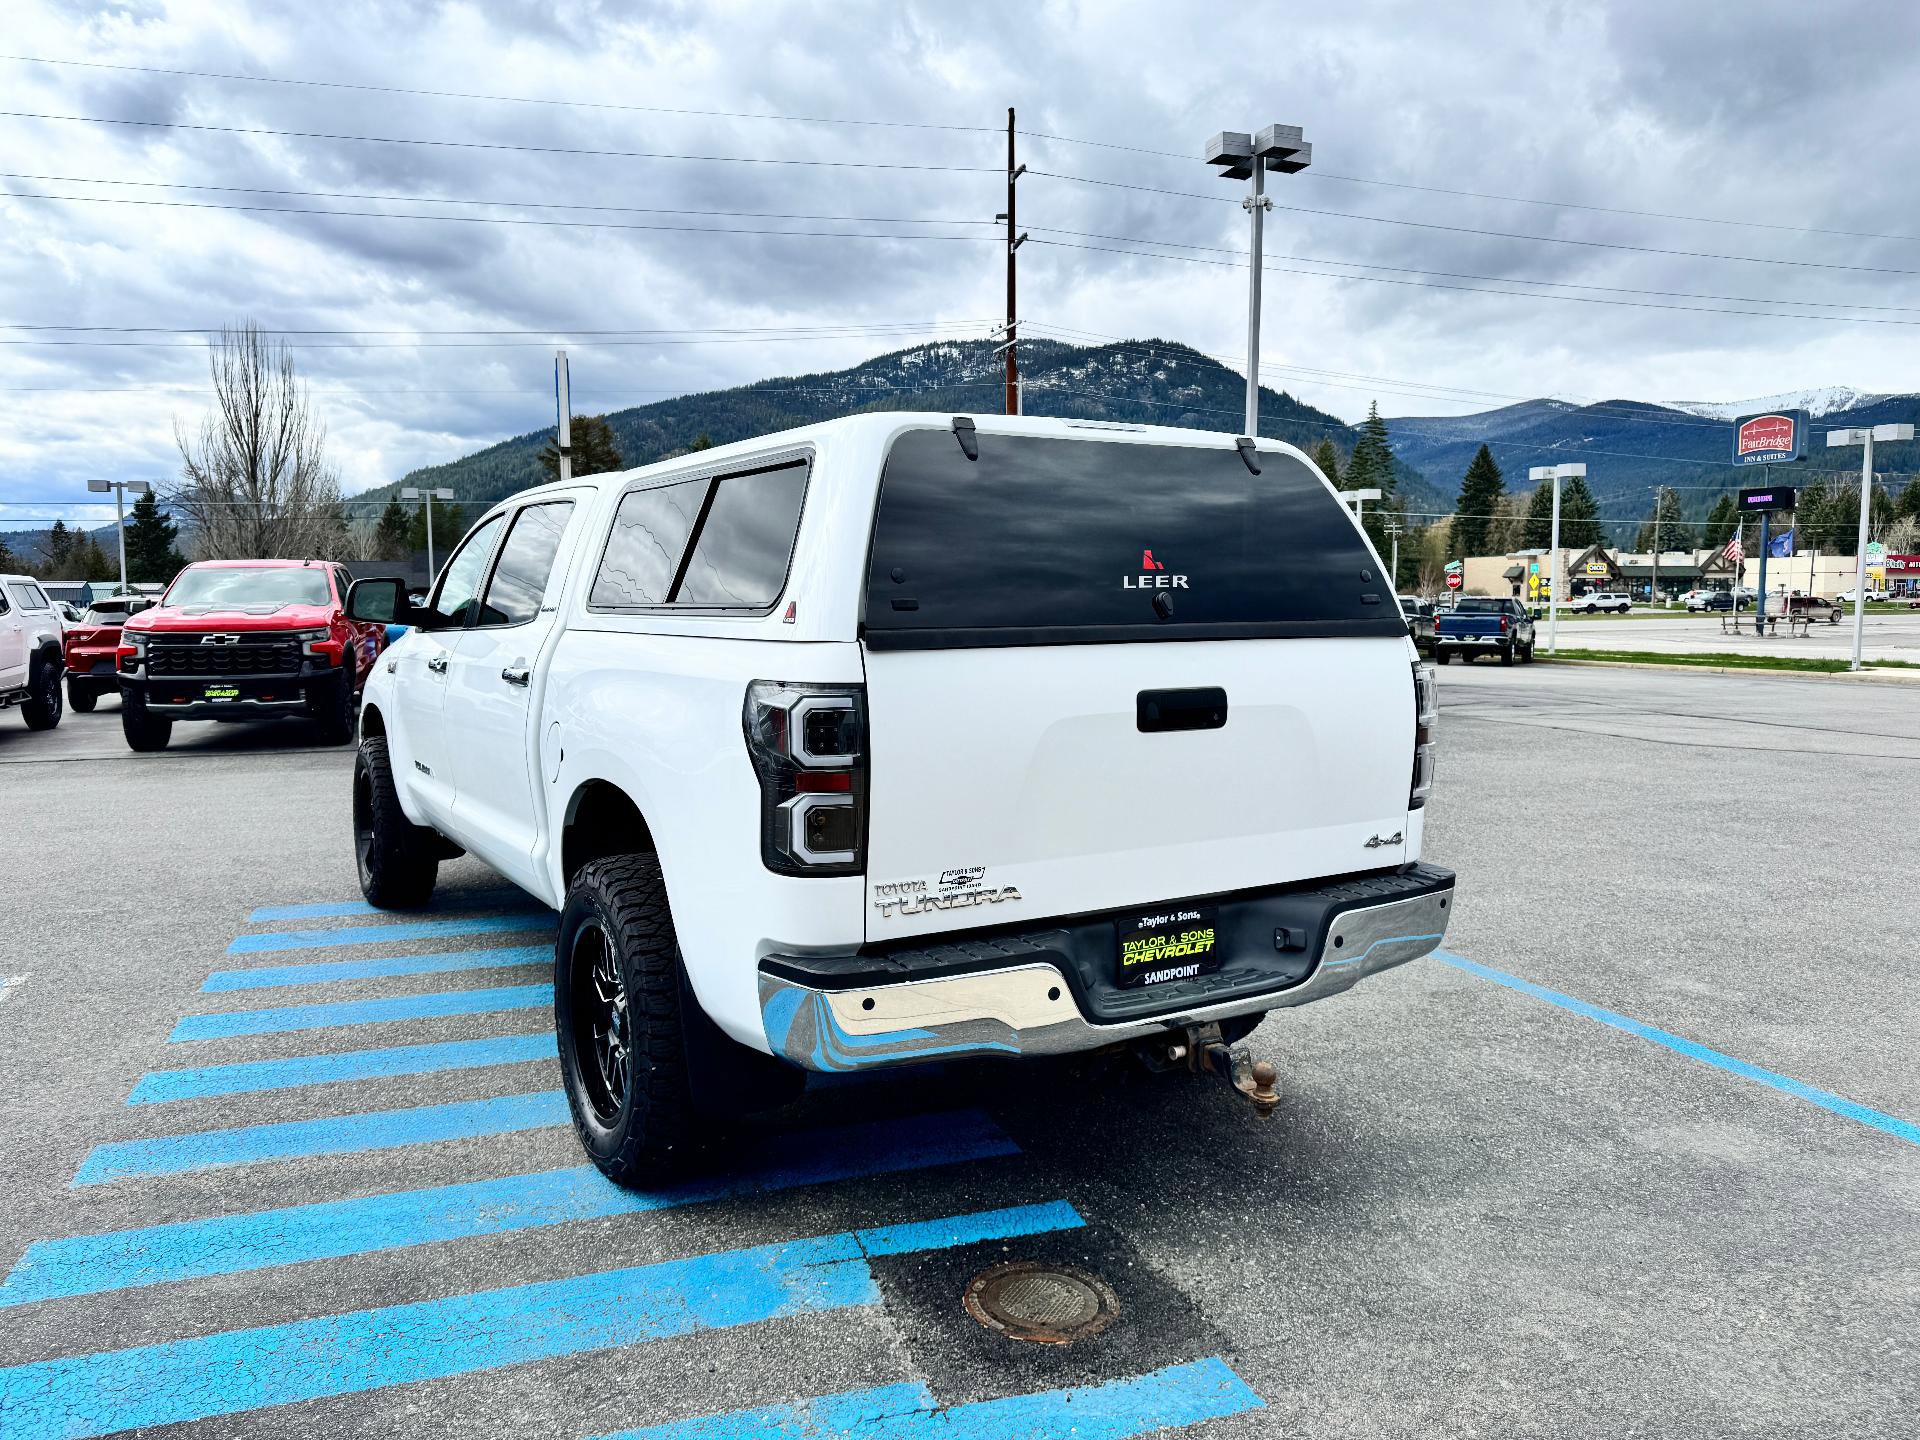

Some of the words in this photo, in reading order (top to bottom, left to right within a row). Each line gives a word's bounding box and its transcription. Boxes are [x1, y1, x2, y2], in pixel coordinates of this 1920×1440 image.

[1741, 435, 1791, 449] FairBridge
[1762, 453, 1786, 461] SUITES
[1123, 575, 1190, 589] LEER
[1447, 577, 1460, 585] STOP
[946, 868, 964, 877] TAYLOR
[874, 880, 928, 896] TOYOTA
[874, 884, 1023, 917] TUNDRA
[1142, 915, 1168, 928] Taylor
[1177, 911, 1197, 921] Sons
[1123, 936, 1166, 952] TAYLOR
[1169, 934, 1177, 946] &
[1180, 929, 1214, 942] SONS
[1123, 940, 1215, 965] CHEVROLET
[1144, 964, 1199, 984] SANDPOINT
